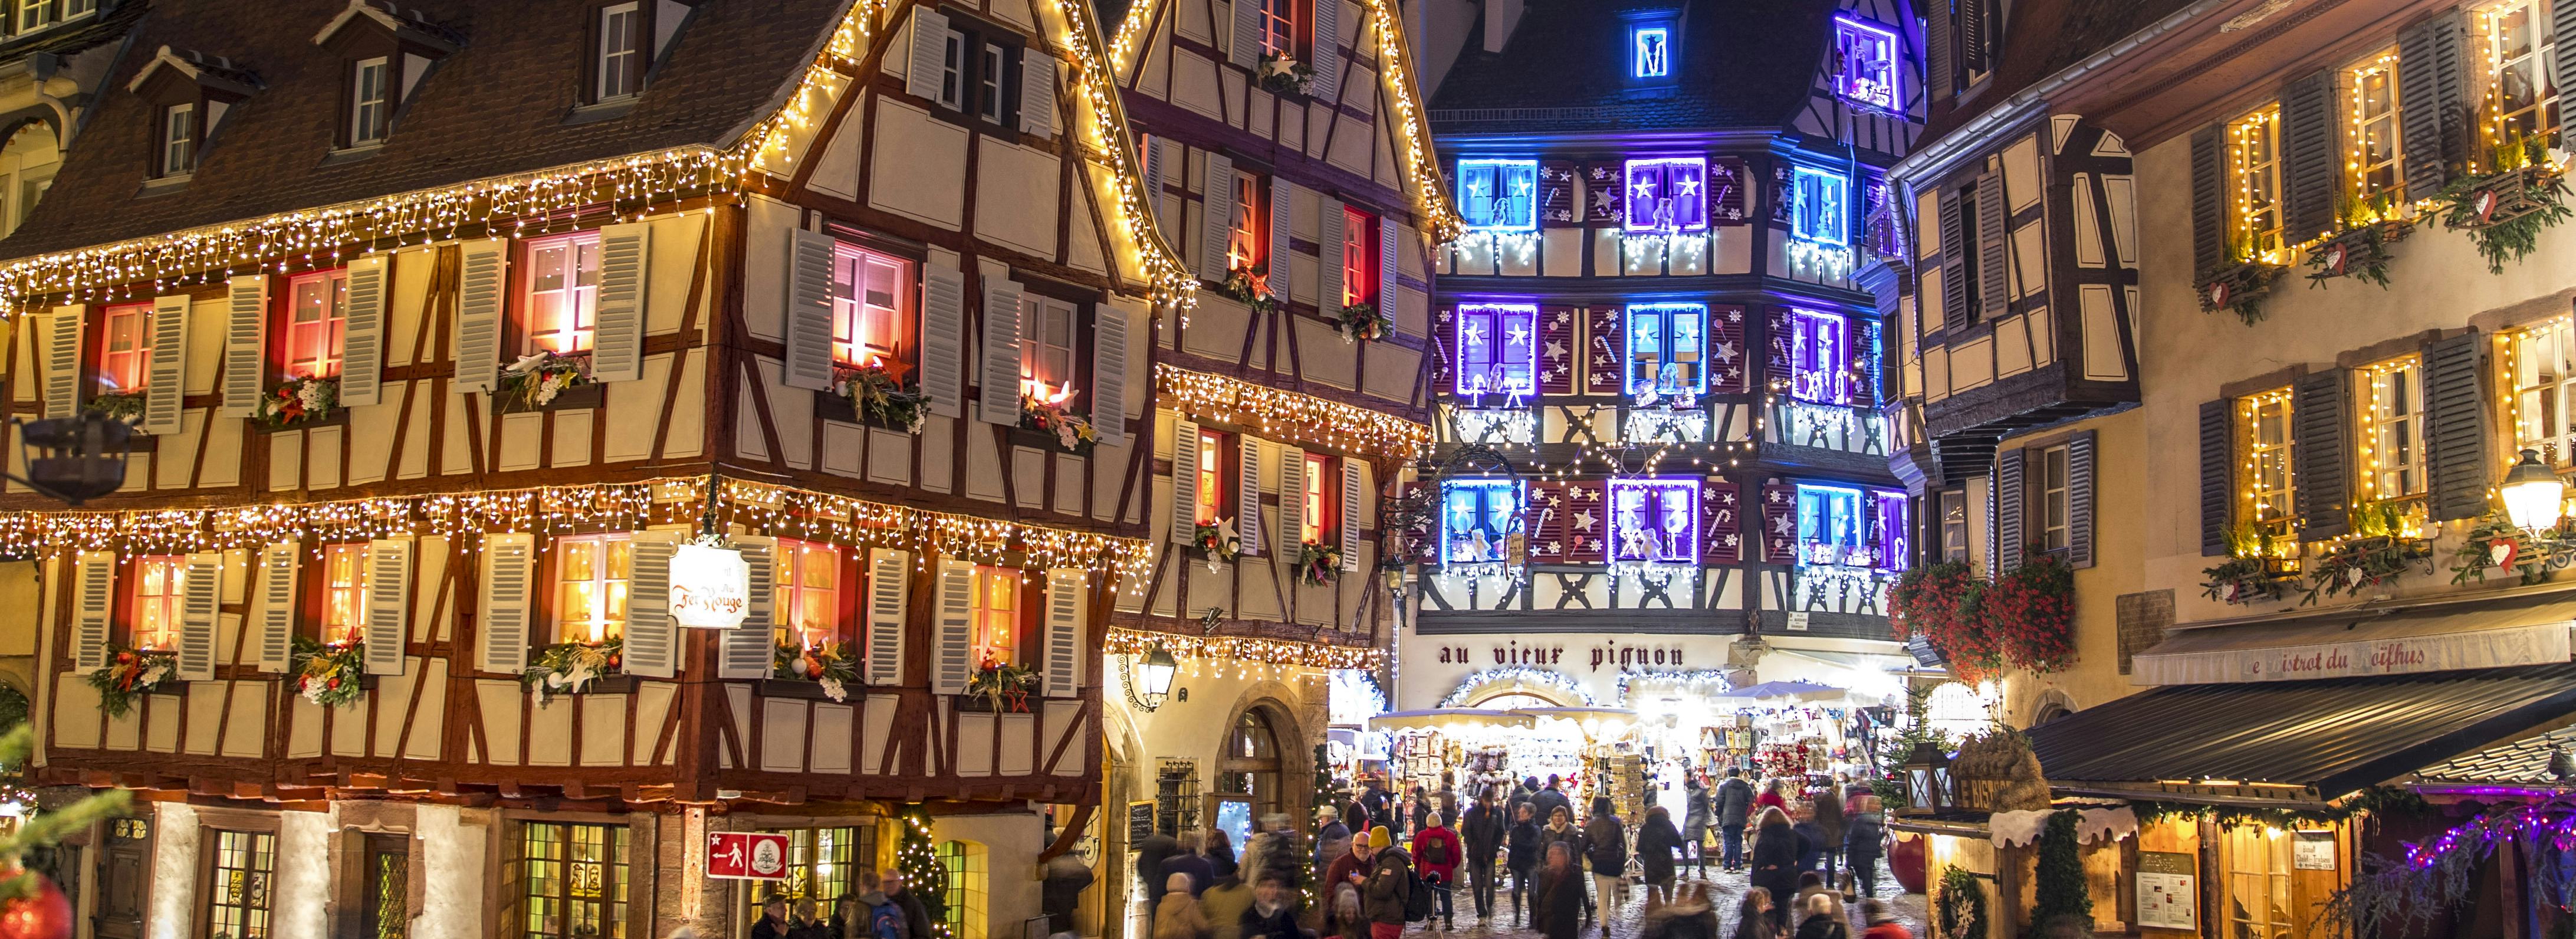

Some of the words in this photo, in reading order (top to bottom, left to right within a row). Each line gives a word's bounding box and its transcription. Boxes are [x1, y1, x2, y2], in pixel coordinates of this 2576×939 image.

[672, 585, 700, 613] Fer
[701, 586, 742, 613] Rouge
[1440, 646, 1468, 665] au
[1493, 639, 1563, 665] vieux
[1590, 639, 1683, 672] pignon
[2266, 652, 2322, 673] istrot
[2327, 648, 2348, 670] du
[2352, 642, 2424, 672] oïfhus
[1972, 780, 2013, 808] BIST
